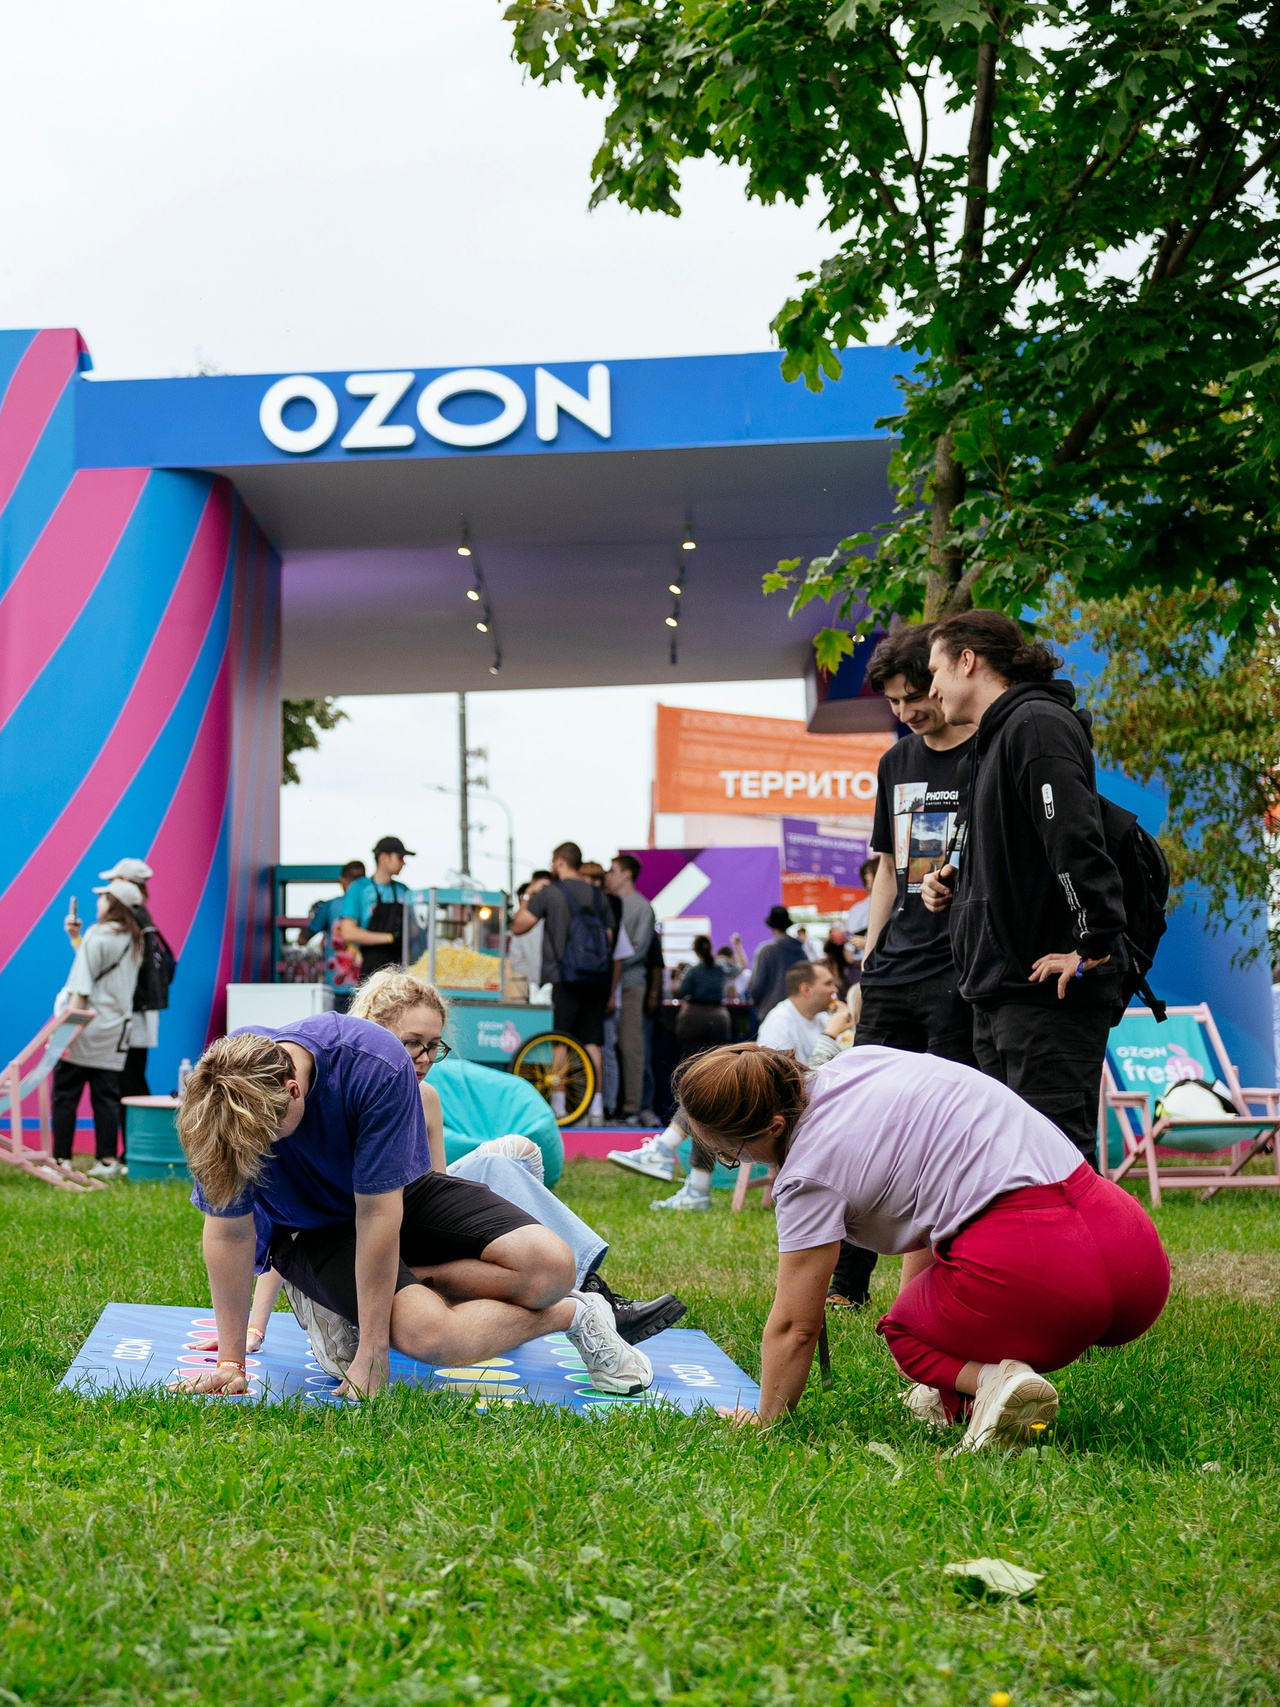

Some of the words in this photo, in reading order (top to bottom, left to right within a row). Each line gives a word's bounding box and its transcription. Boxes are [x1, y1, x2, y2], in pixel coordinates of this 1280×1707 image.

[259, 363, 612, 453] OZON
[477, 1021, 506, 1030] OZON
[477, 1030, 517, 1048] fresh
[1116, 1046, 1168, 1059] OZON
[1122, 1058, 1197, 1084] fresh
[111, 1337, 154, 1360] OZON
[668, 1363, 721, 1387] OZON
